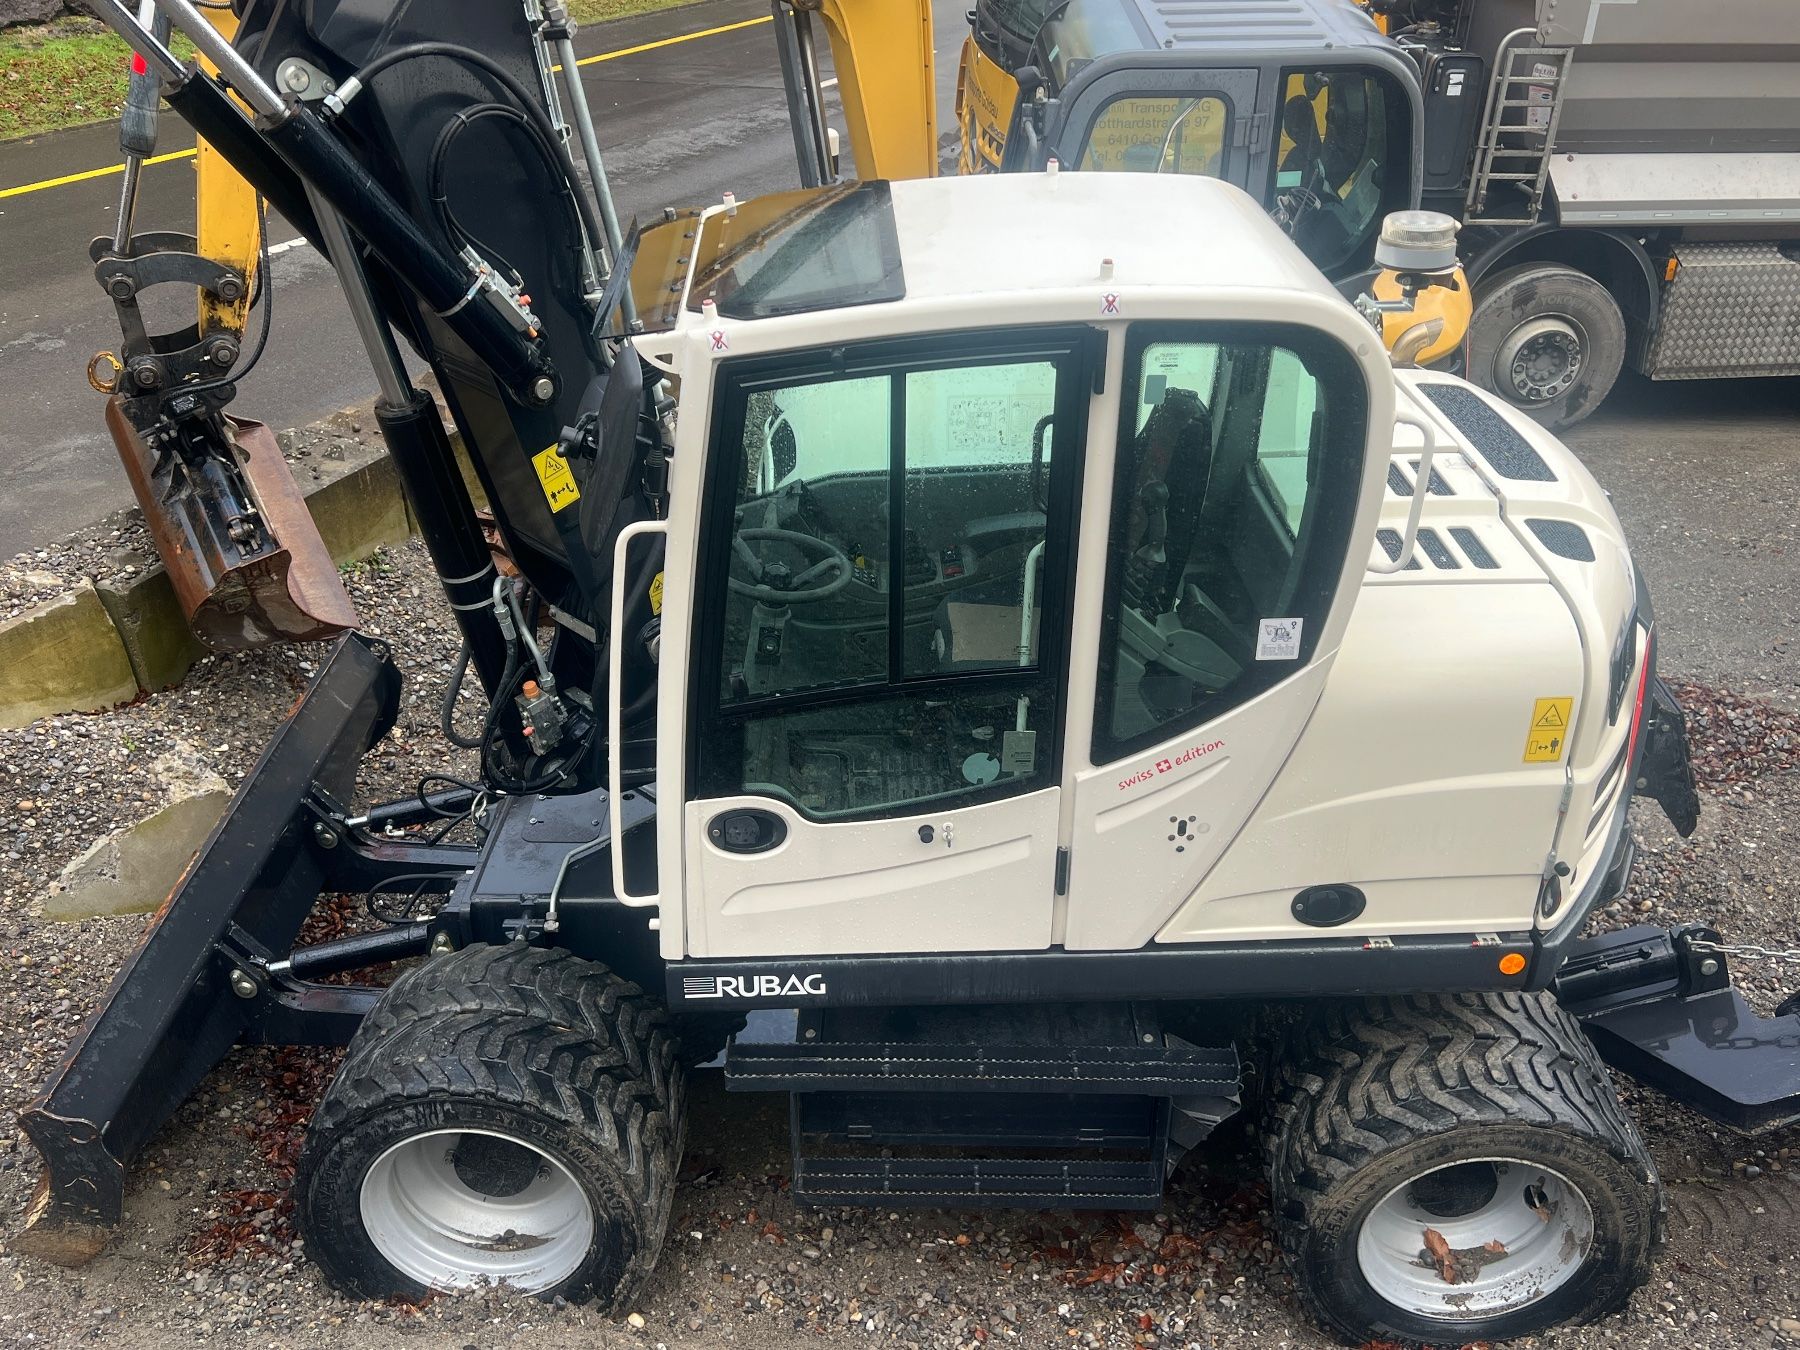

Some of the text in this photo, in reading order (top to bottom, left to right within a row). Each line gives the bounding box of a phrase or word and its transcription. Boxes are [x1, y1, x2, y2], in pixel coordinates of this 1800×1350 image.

[1194, 116, 1210, 128] 97
[1118, 739, 1226, 791] swiss edition
[714, 973, 827, 998] RUBAG
